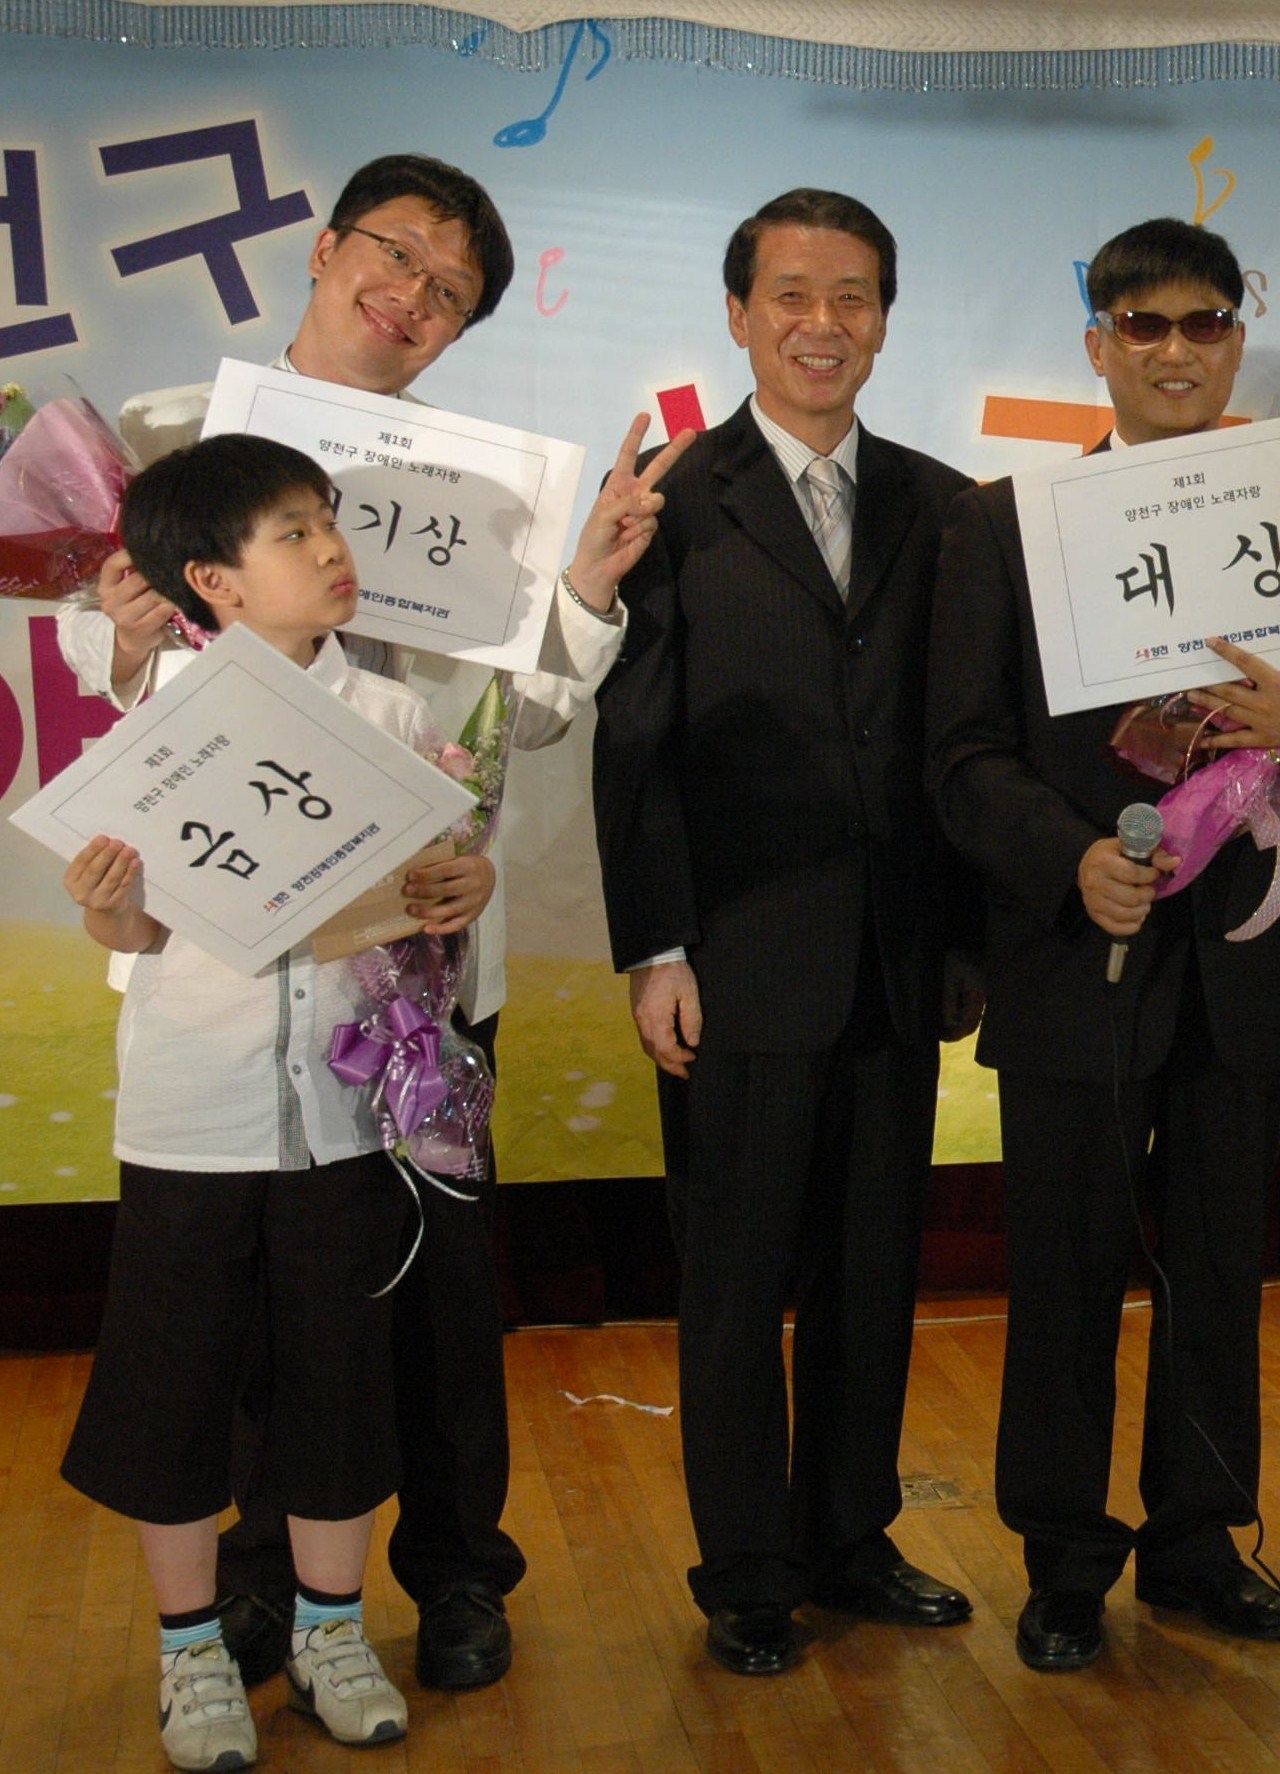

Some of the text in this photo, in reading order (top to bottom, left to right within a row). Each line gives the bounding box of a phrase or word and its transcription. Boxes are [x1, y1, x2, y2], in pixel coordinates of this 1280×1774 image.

[378, 431, 413, 451] 제1회
[318, 438, 462, 485] 양천구 장애인 노래자랑
[1172, 471, 1207, 489] 제1회
[1124, 484, 1262, 523] 양천구 장애인 노래자랑
[329, 484, 468, 567] 기상
[358, 587, 451, 619] 애인종합복지관
[133, 733, 231, 813] 양천구 장애인 노래자랑
[144, 745, 174, 768] 제1회
